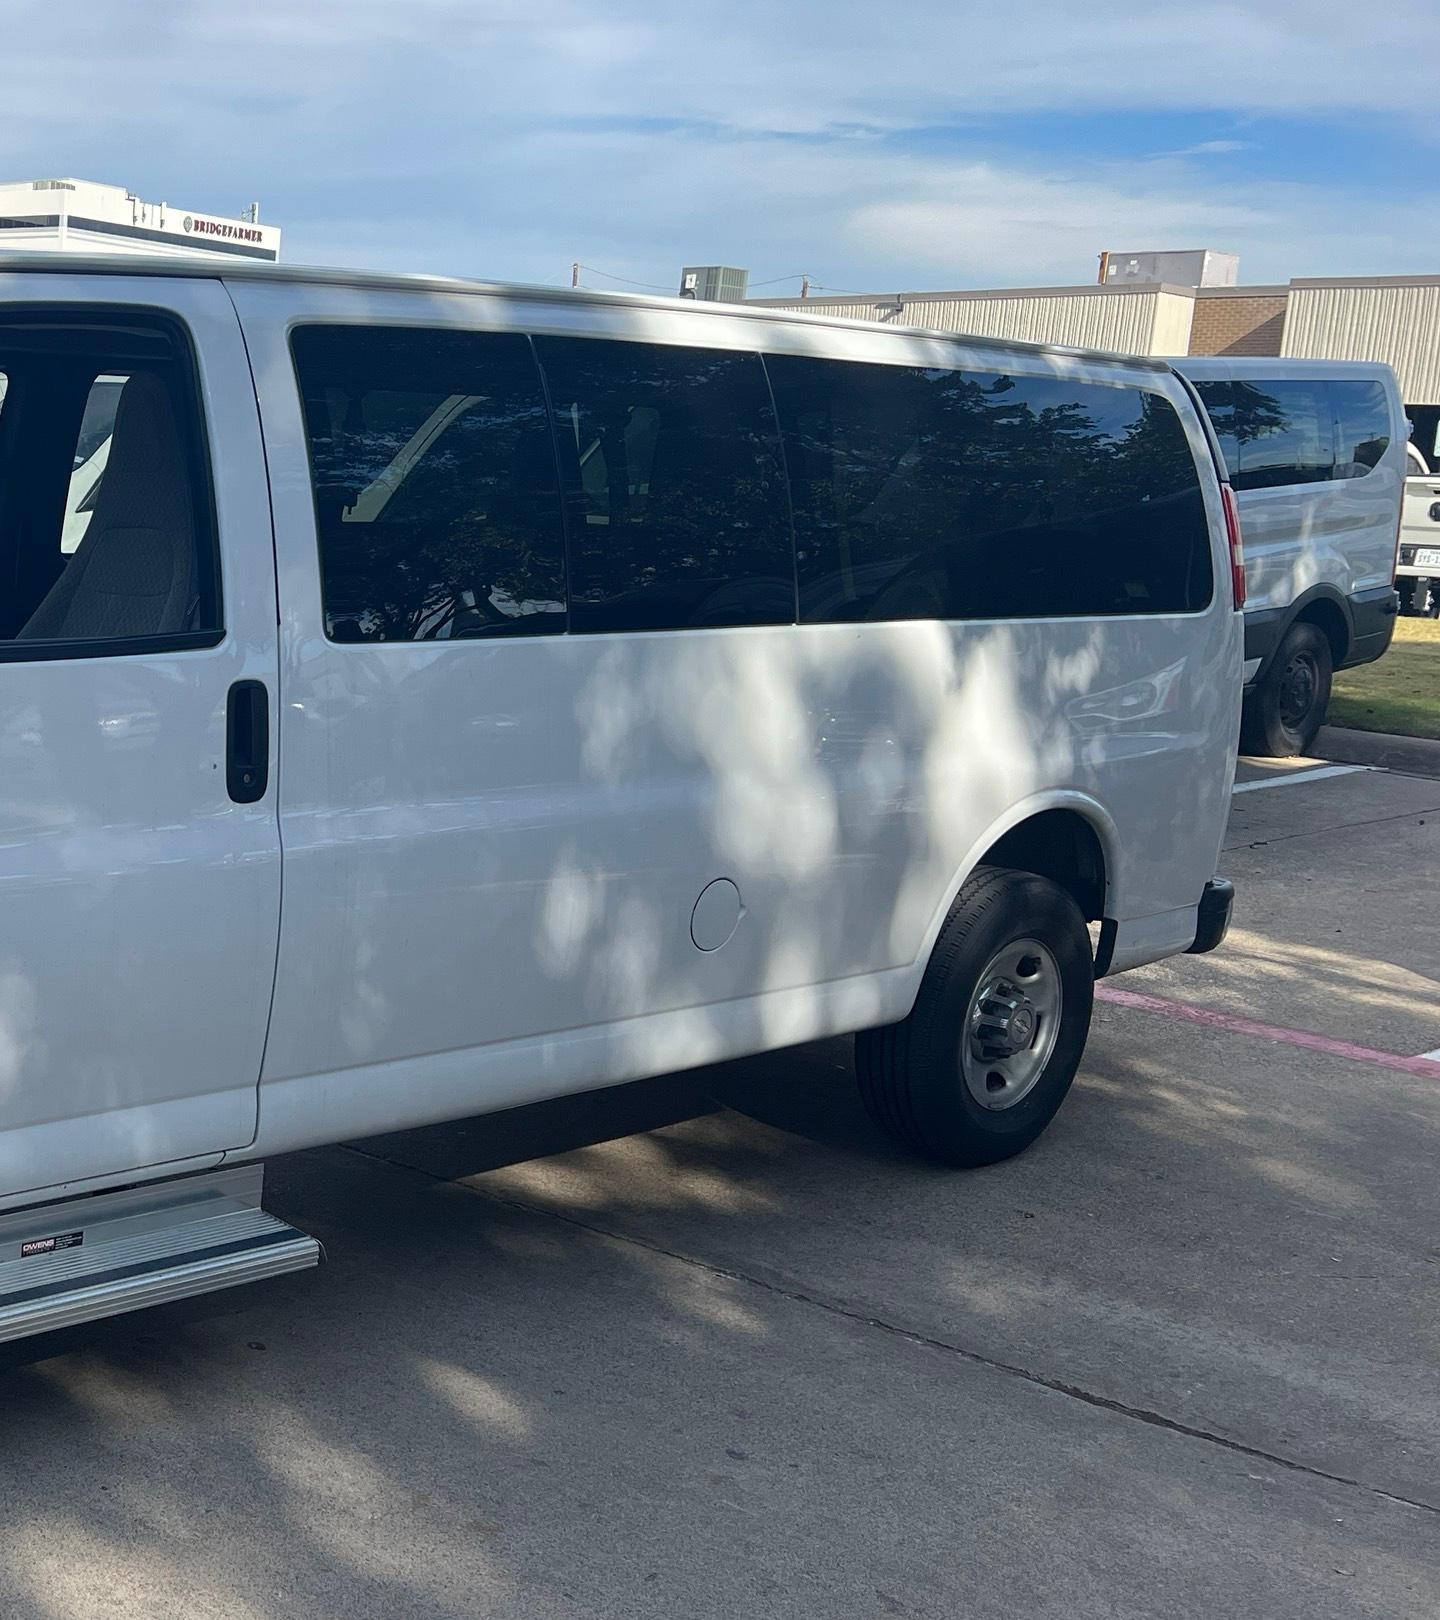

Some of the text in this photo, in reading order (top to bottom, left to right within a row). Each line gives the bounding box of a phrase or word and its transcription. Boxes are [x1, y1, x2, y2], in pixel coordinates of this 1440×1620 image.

[193, 219, 263, 243] BRIDGEFARMER
[1417, 554, 1440, 564] SYS-1
[23, 1239, 55, 1252] OWENS
